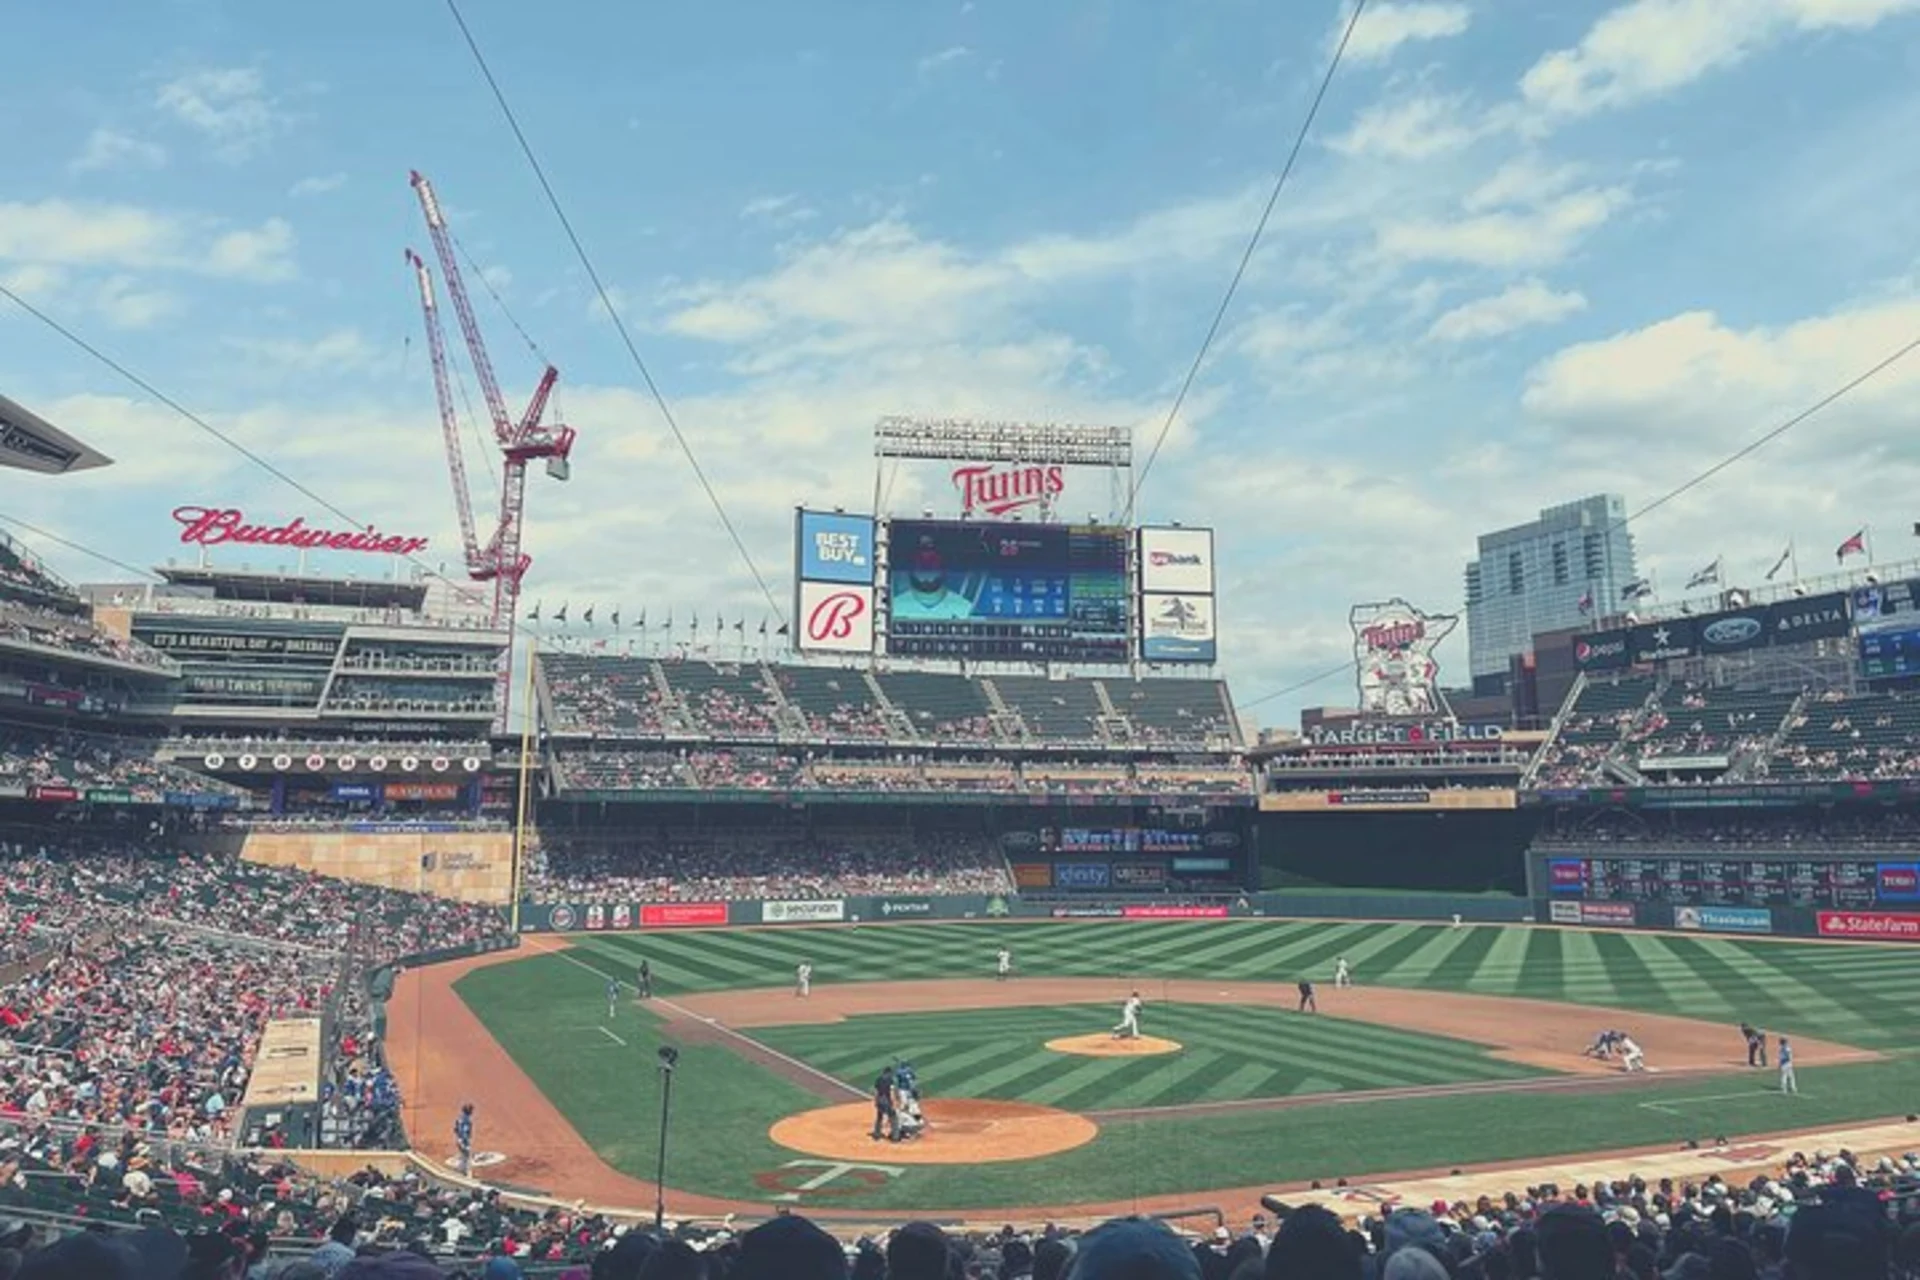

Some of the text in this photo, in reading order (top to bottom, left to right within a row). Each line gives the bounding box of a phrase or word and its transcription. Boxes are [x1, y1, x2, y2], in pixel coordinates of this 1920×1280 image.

[952, 464, 1064, 514] Twins
[172, 506, 428, 554] Budweiser
[815, 532, 860, 548] BEST
[807, 592, 865, 641] B
[1791, 608, 1842, 627] DELTA
[1361, 621, 1424, 647] Twins
[1711, 622, 1751, 640] Ford
[1592, 640, 1624, 657] pepsi
[1311, 723, 1503, 745] TARGET FIELD
